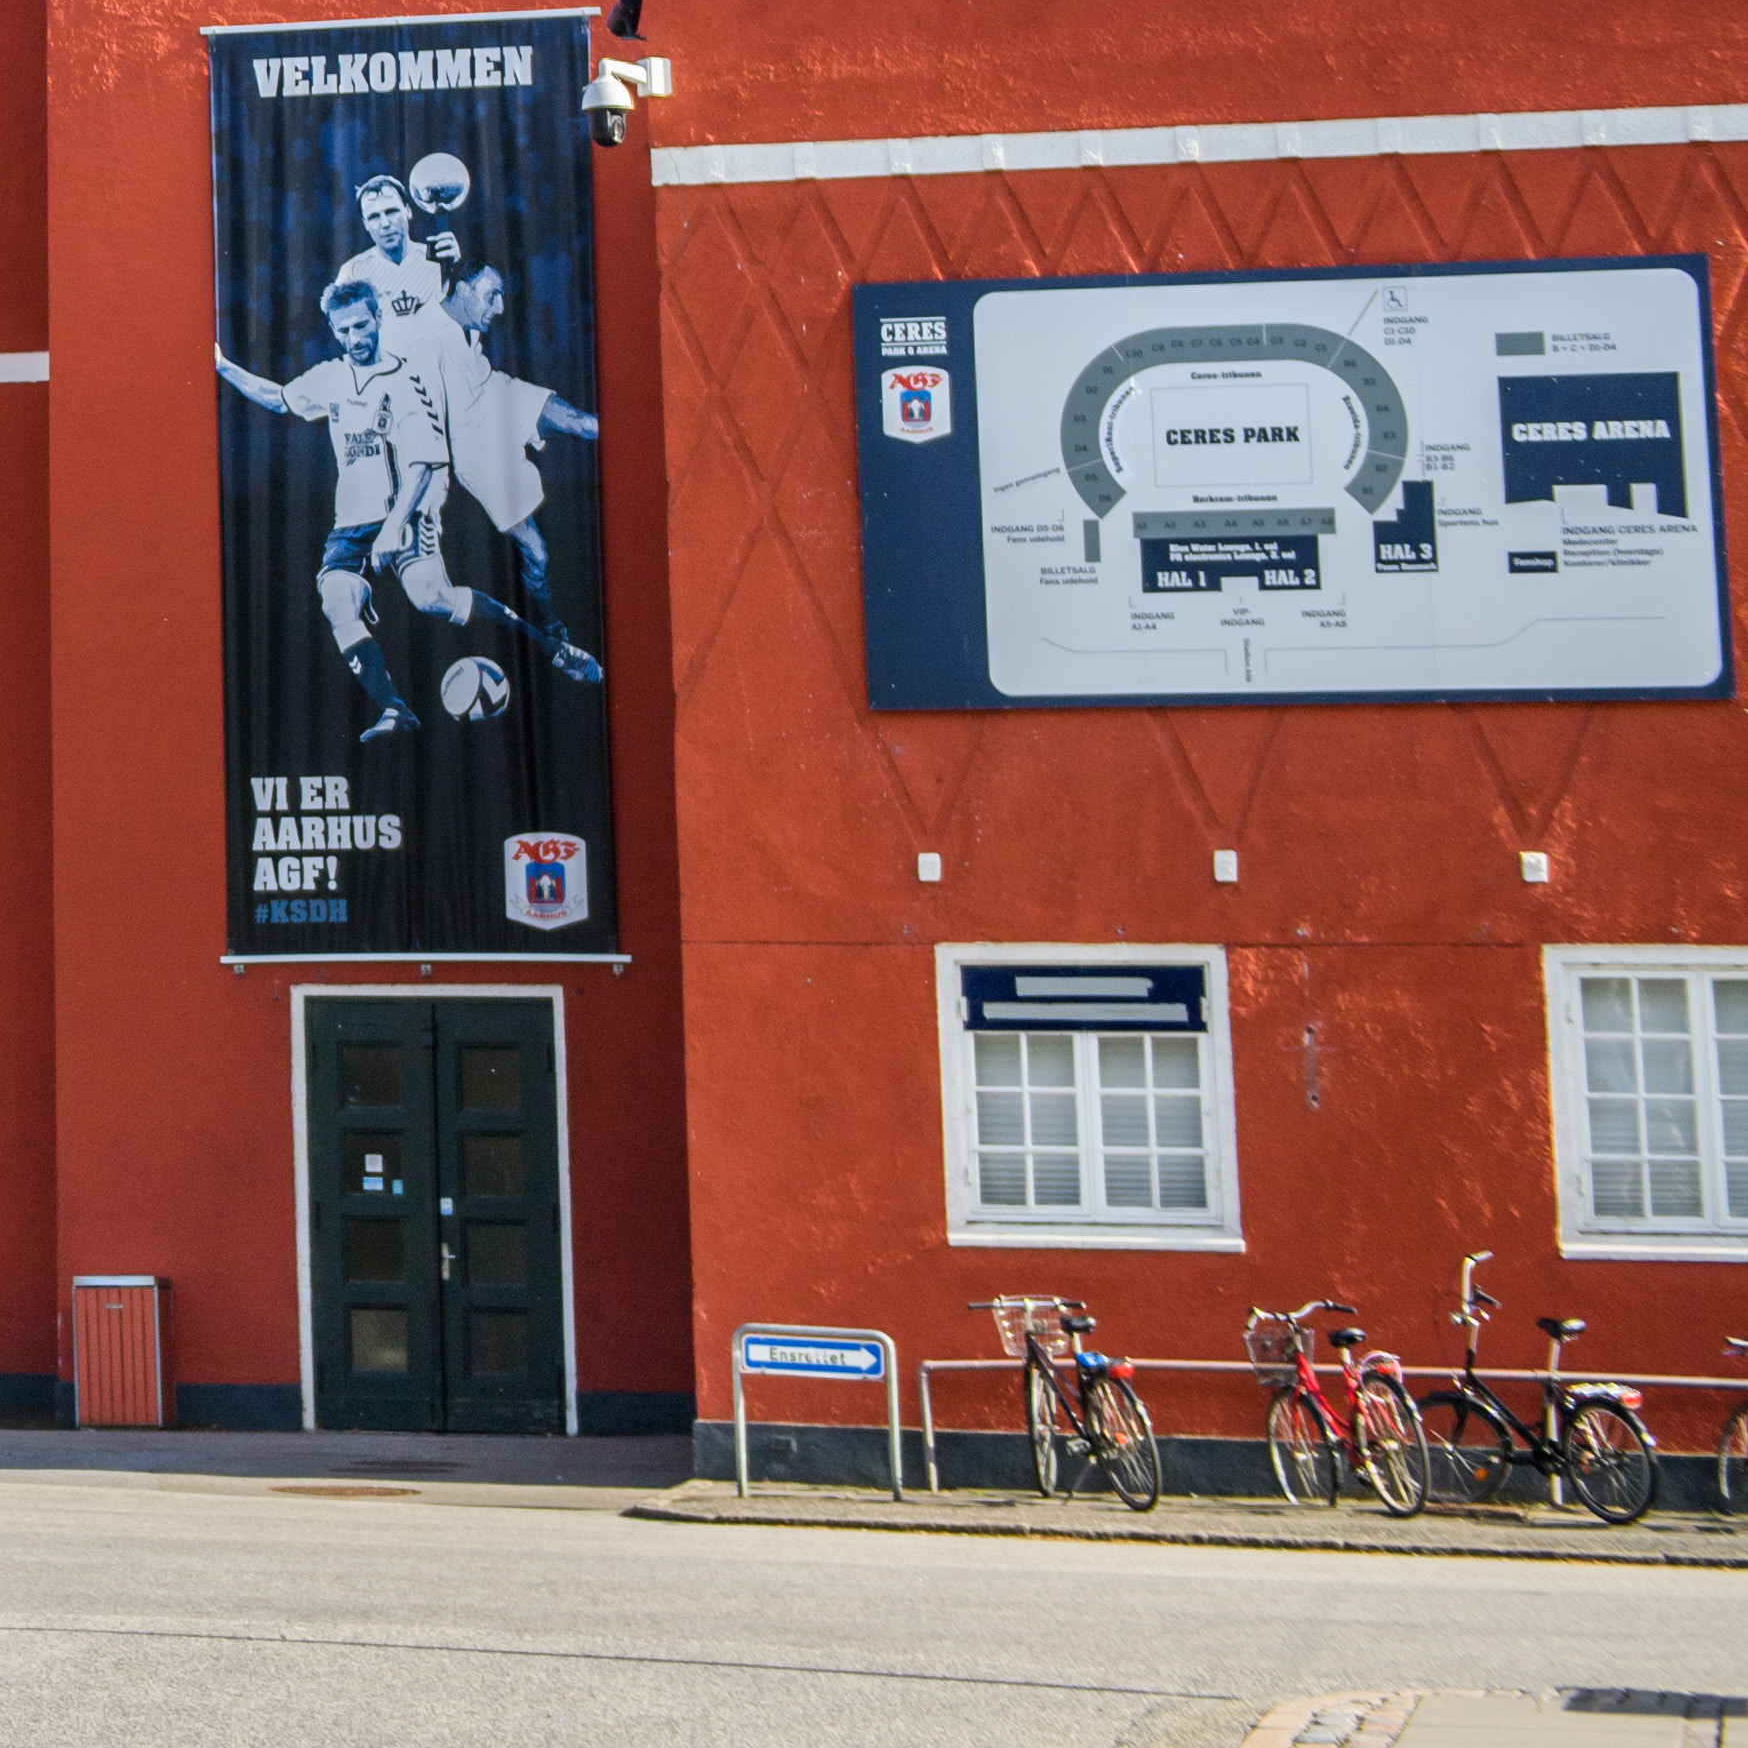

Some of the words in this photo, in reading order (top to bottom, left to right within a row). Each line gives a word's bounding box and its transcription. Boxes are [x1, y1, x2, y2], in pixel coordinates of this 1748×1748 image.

[253, 45, 533, 98] VELKOMMEN
[1383, 316, 1429, 325] INDGANG
[881, 322, 946, 342] CERES
[1552, 332, 1611, 341] BILLETSALG
[1191, 371, 1262, 380] Ceres-tribunen
[1166, 427, 1236, 446] CERES
[1243, 426, 1300, 443] PARK
[1512, 421, 1588, 442] CERES
[1592, 419, 1671, 440] ARENA
[1425, 444, 1471, 452] INDGANG
[1437, 508, 1482, 516] INDGANG
[991, 525, 1034, 533] INDGANG
[1562, 526, 1616, 535] INDGANG
[1618, 525, 1656, 534] CERES
[1659, 524, 1698, 533] ARENA
[1029, 535, 1065, 543] udehold
[1379, 544, 1416, 561] HAL
[1419, 543, 1433, 559] 3
[1041, 566, 1096, 575] BILLETSALG
[1040, 578, 1060, 586] Fans
[1062, 577, 1098, 585] udehold
[1157, 571, 1193, 588] HAL
[1198, 571, 1206, 587] 1
[1264, 569, 1300, 586] HAL
[1304, 569, 1317, 585] 2
[1130, 612, 1175, 620] INDGANG
[1301, 610, 1346, 618] INDGANG
[1220, 619, 1265, 627] INDGANG
[251, 777, 288, 811] VI
[300, 775, 350, 810] ER
[253, 814, 402, 851] AARHUS
[254, 856, 338, 891] AGF!
[254, 899, 348, 924] #KSDH
[526, 910, 567, 921] AARHUS
